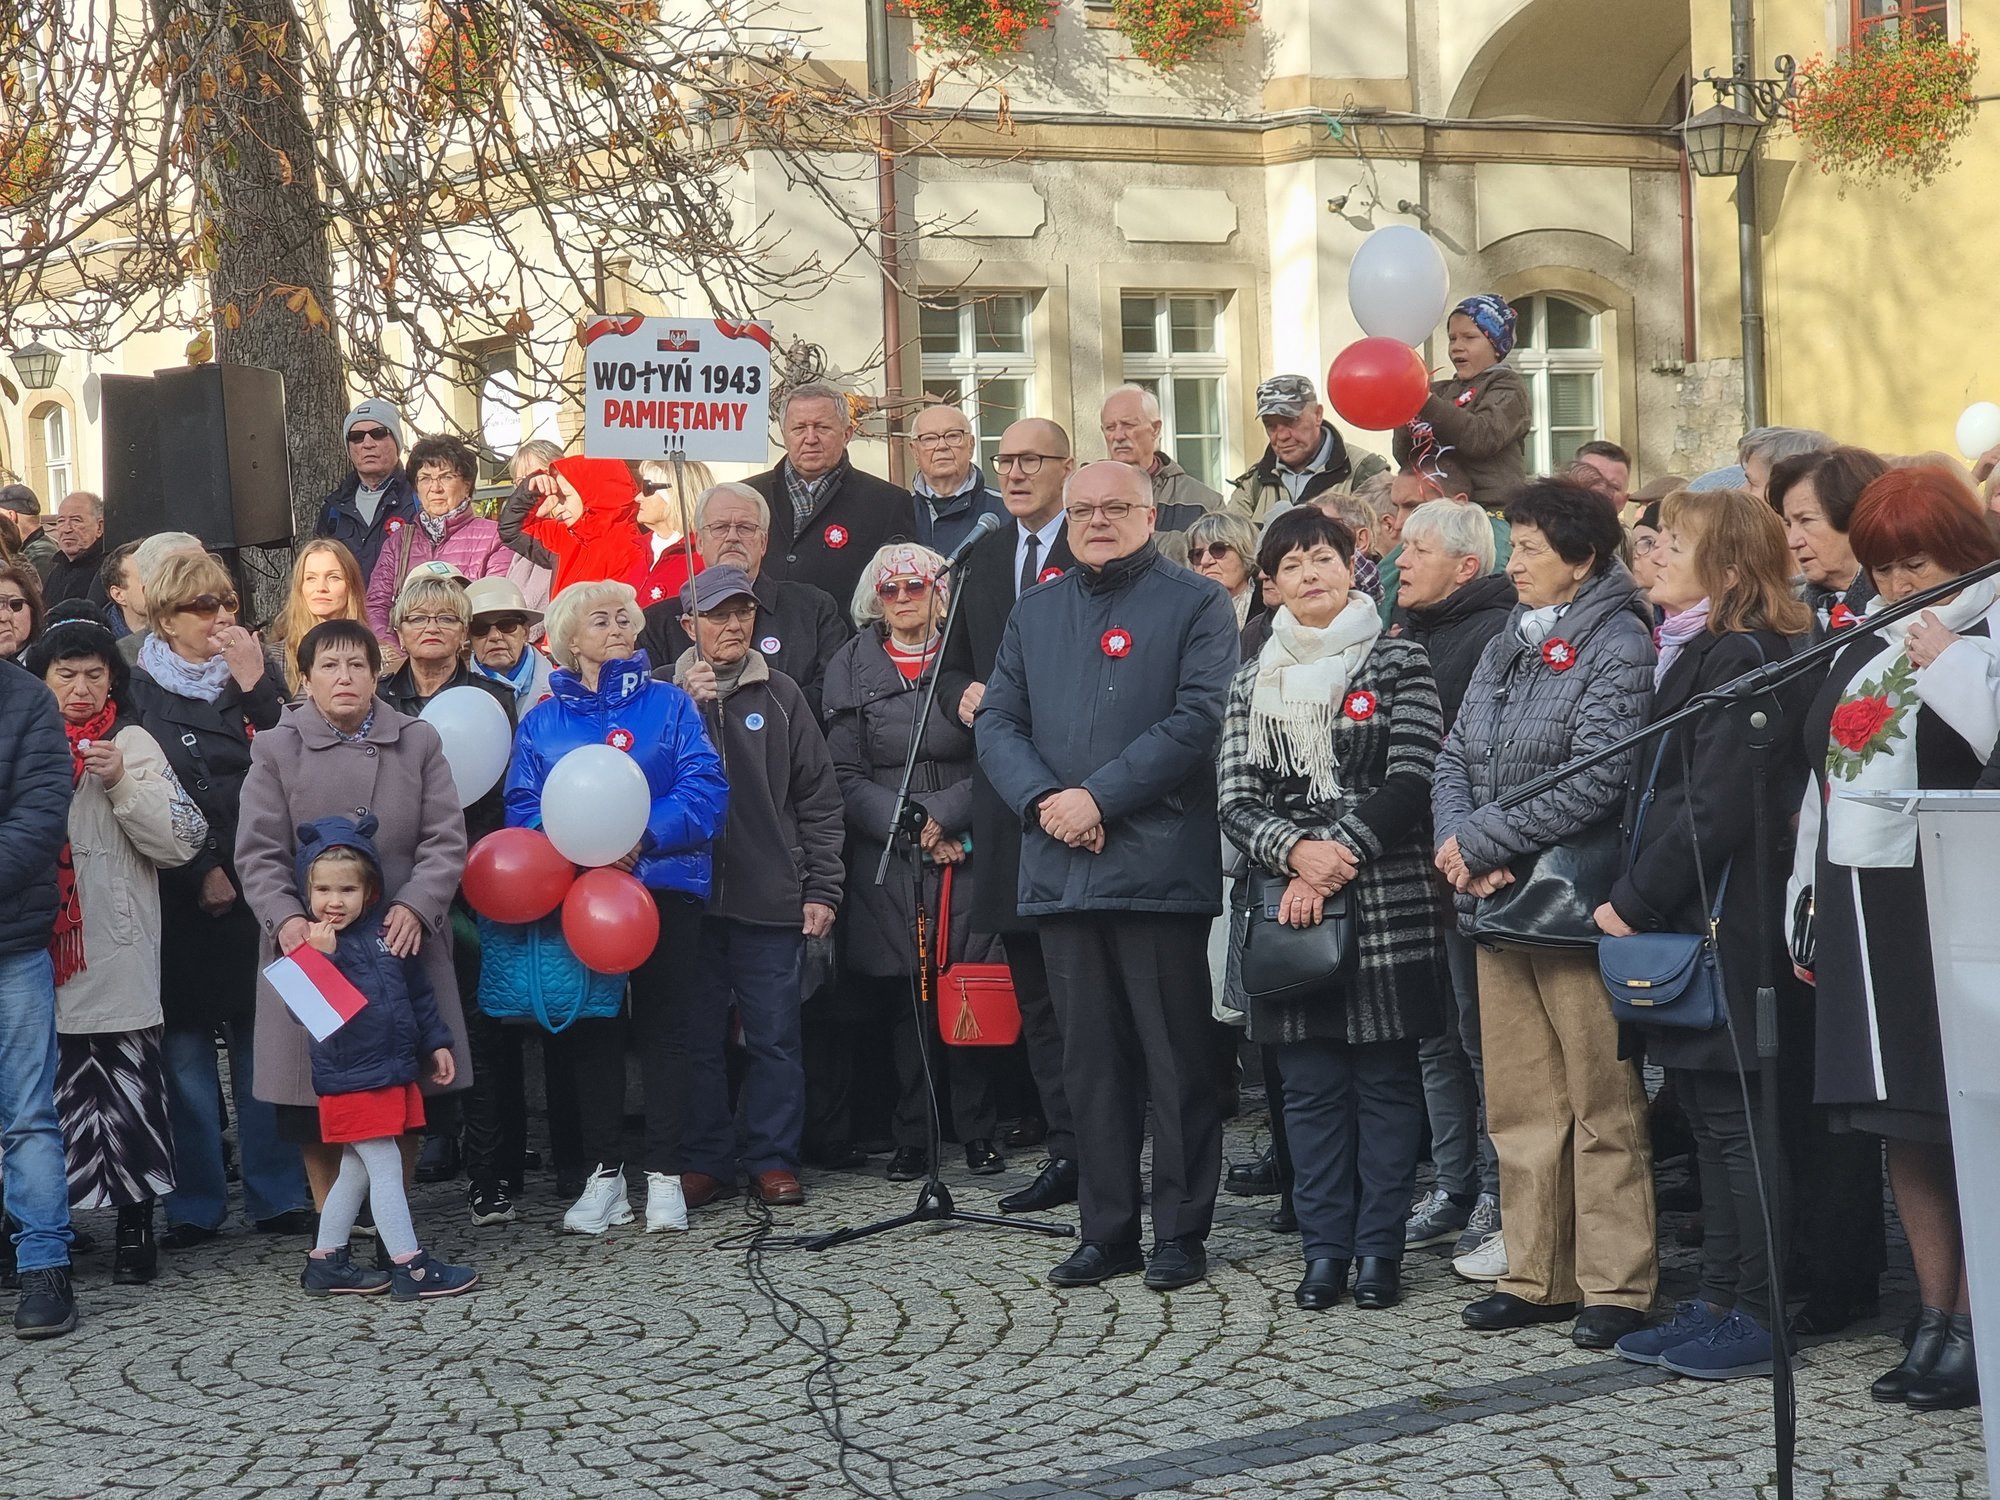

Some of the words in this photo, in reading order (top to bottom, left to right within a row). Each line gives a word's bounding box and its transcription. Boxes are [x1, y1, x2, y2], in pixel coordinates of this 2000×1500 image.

[699, 365, 762, 395] 1943
[604, 399, 748, 433] PAMIĘTAMY
[918, 913, 928, 1002] ATHLETIC
